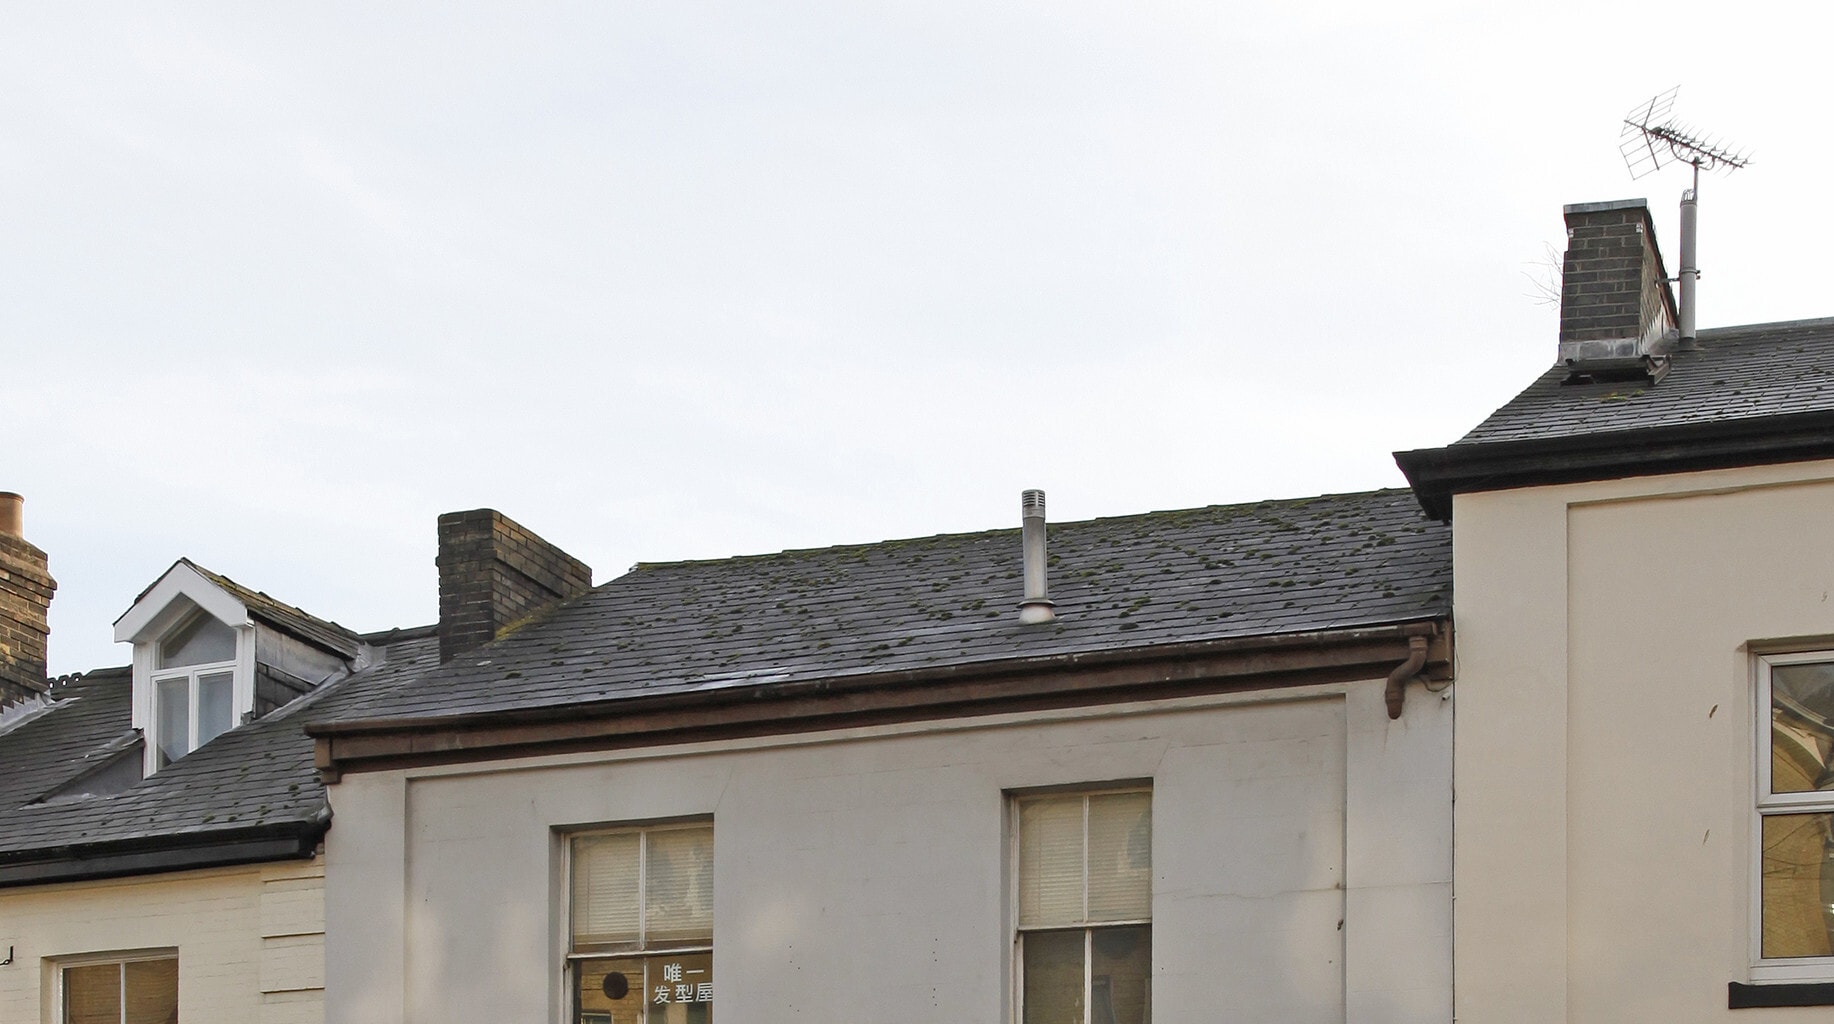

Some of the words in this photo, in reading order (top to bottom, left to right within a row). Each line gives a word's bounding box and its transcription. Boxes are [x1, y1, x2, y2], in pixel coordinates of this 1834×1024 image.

[664, 963, 704, 983] 唯一
[653, 983, 713, 1004] 发型屋
